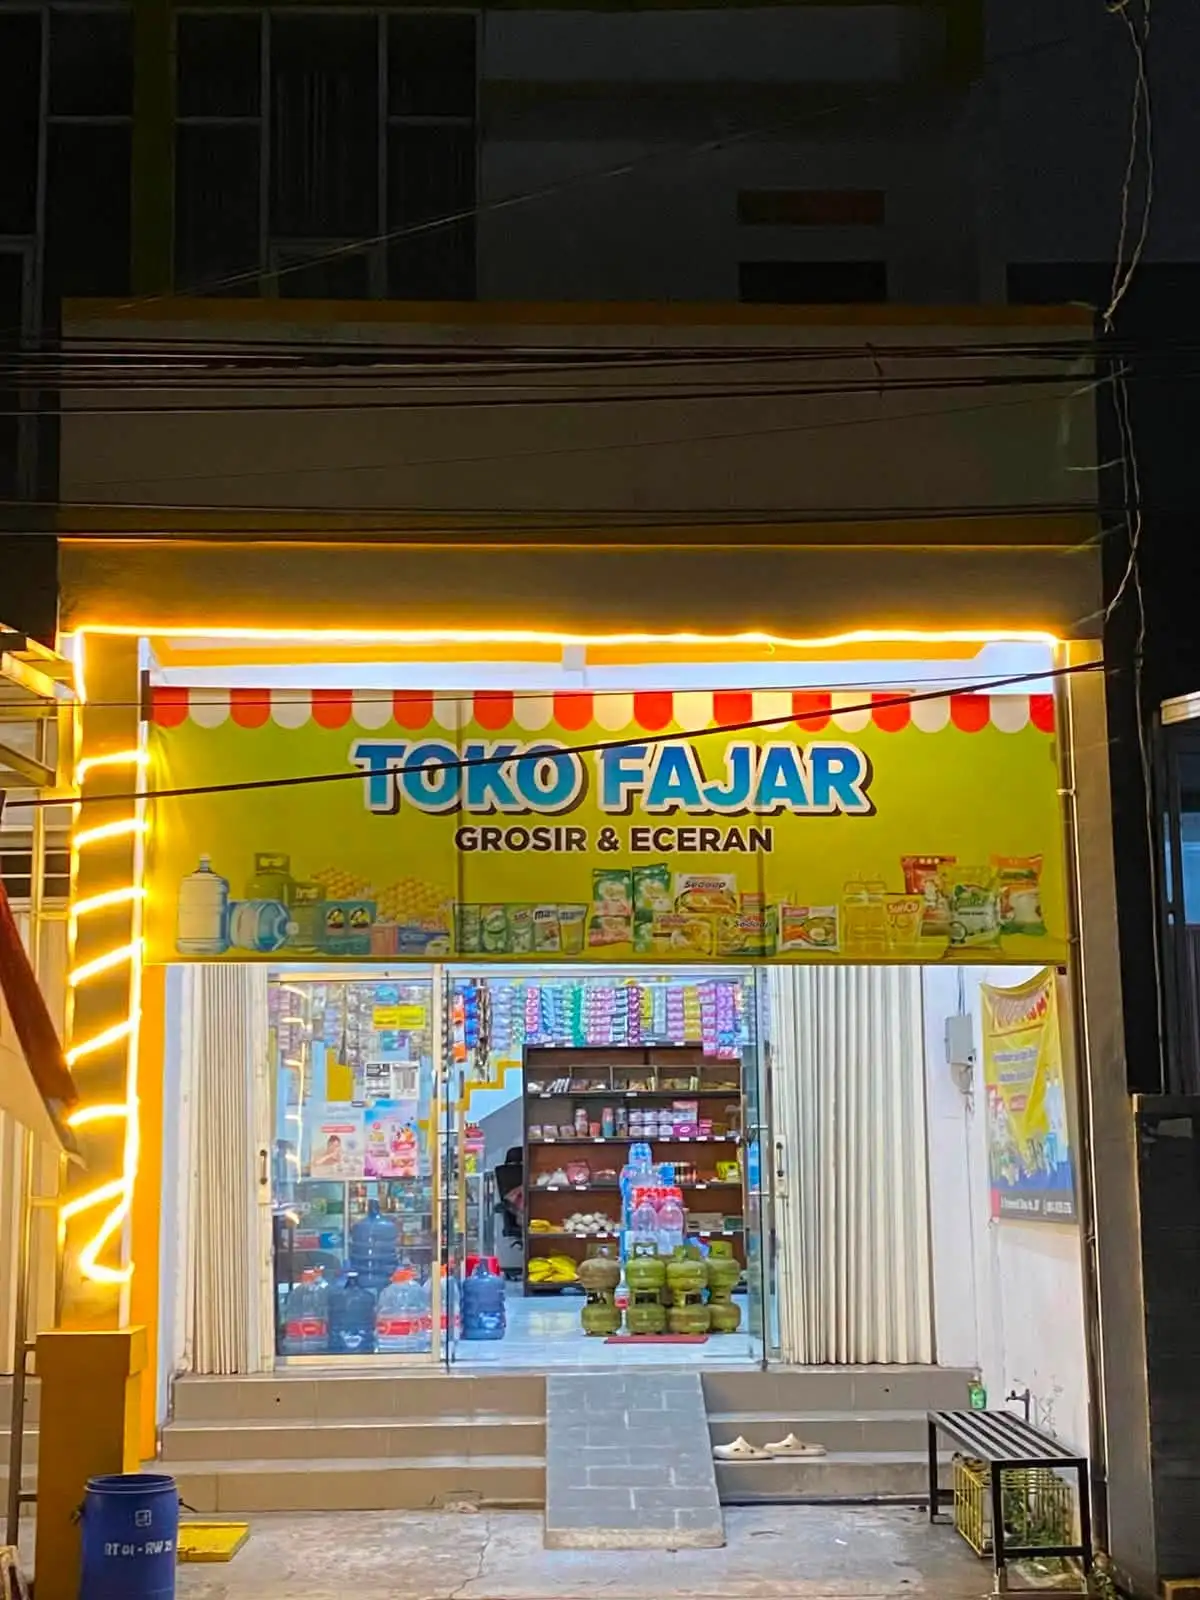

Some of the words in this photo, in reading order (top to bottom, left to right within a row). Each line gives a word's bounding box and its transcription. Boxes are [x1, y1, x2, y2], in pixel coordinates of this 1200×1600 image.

[350, 739, 588, 816] TOKO
[594, 740, 876, 817] FAJAR
[455, 826, 588, 852] GROSIR
[597, 826, 619, 852] &
[630, 827, 773, 852] ECERAN
